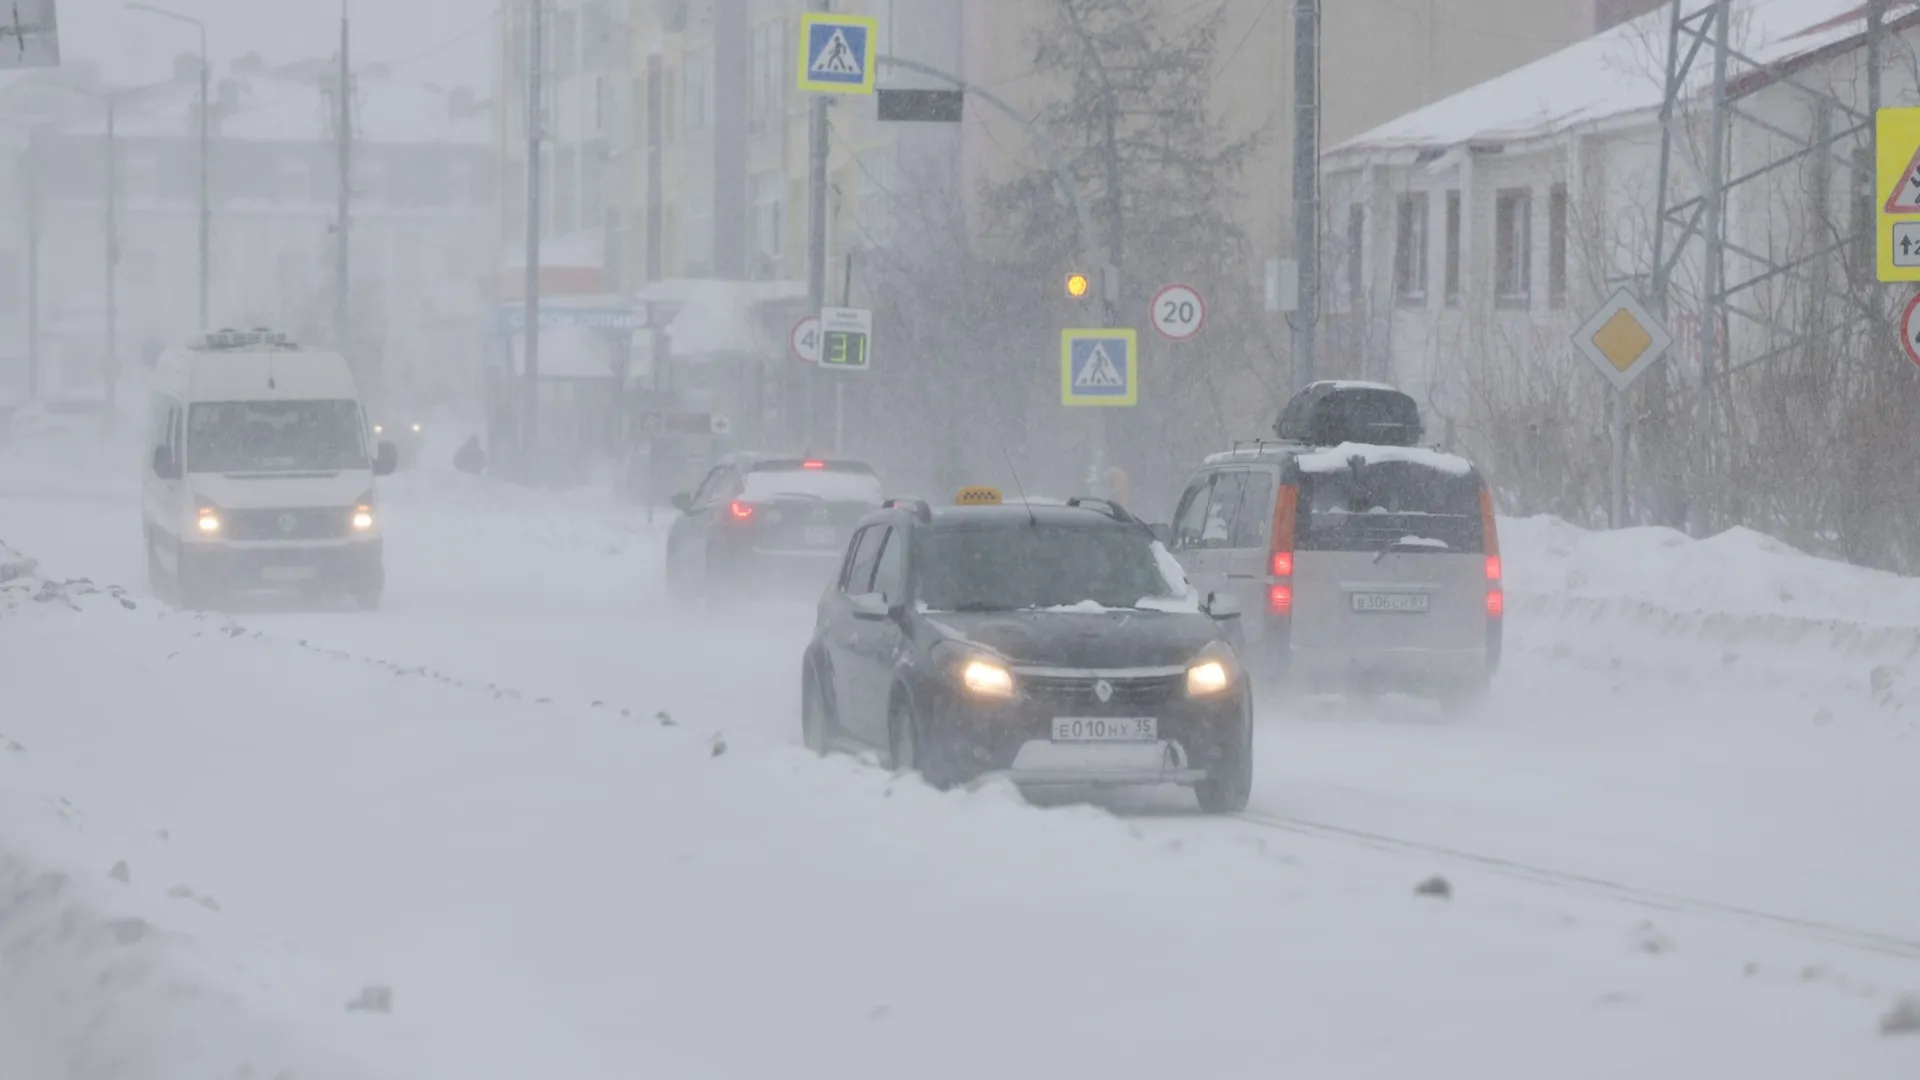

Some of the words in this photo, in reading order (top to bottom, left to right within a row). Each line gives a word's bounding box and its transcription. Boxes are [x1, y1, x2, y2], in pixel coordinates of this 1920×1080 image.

[1163, 301, 1194, 323] 20
[801, 330, 819, 350] 4
[830, 333, 864, 362] 31
[1134, 719, 1151, 732] 35
